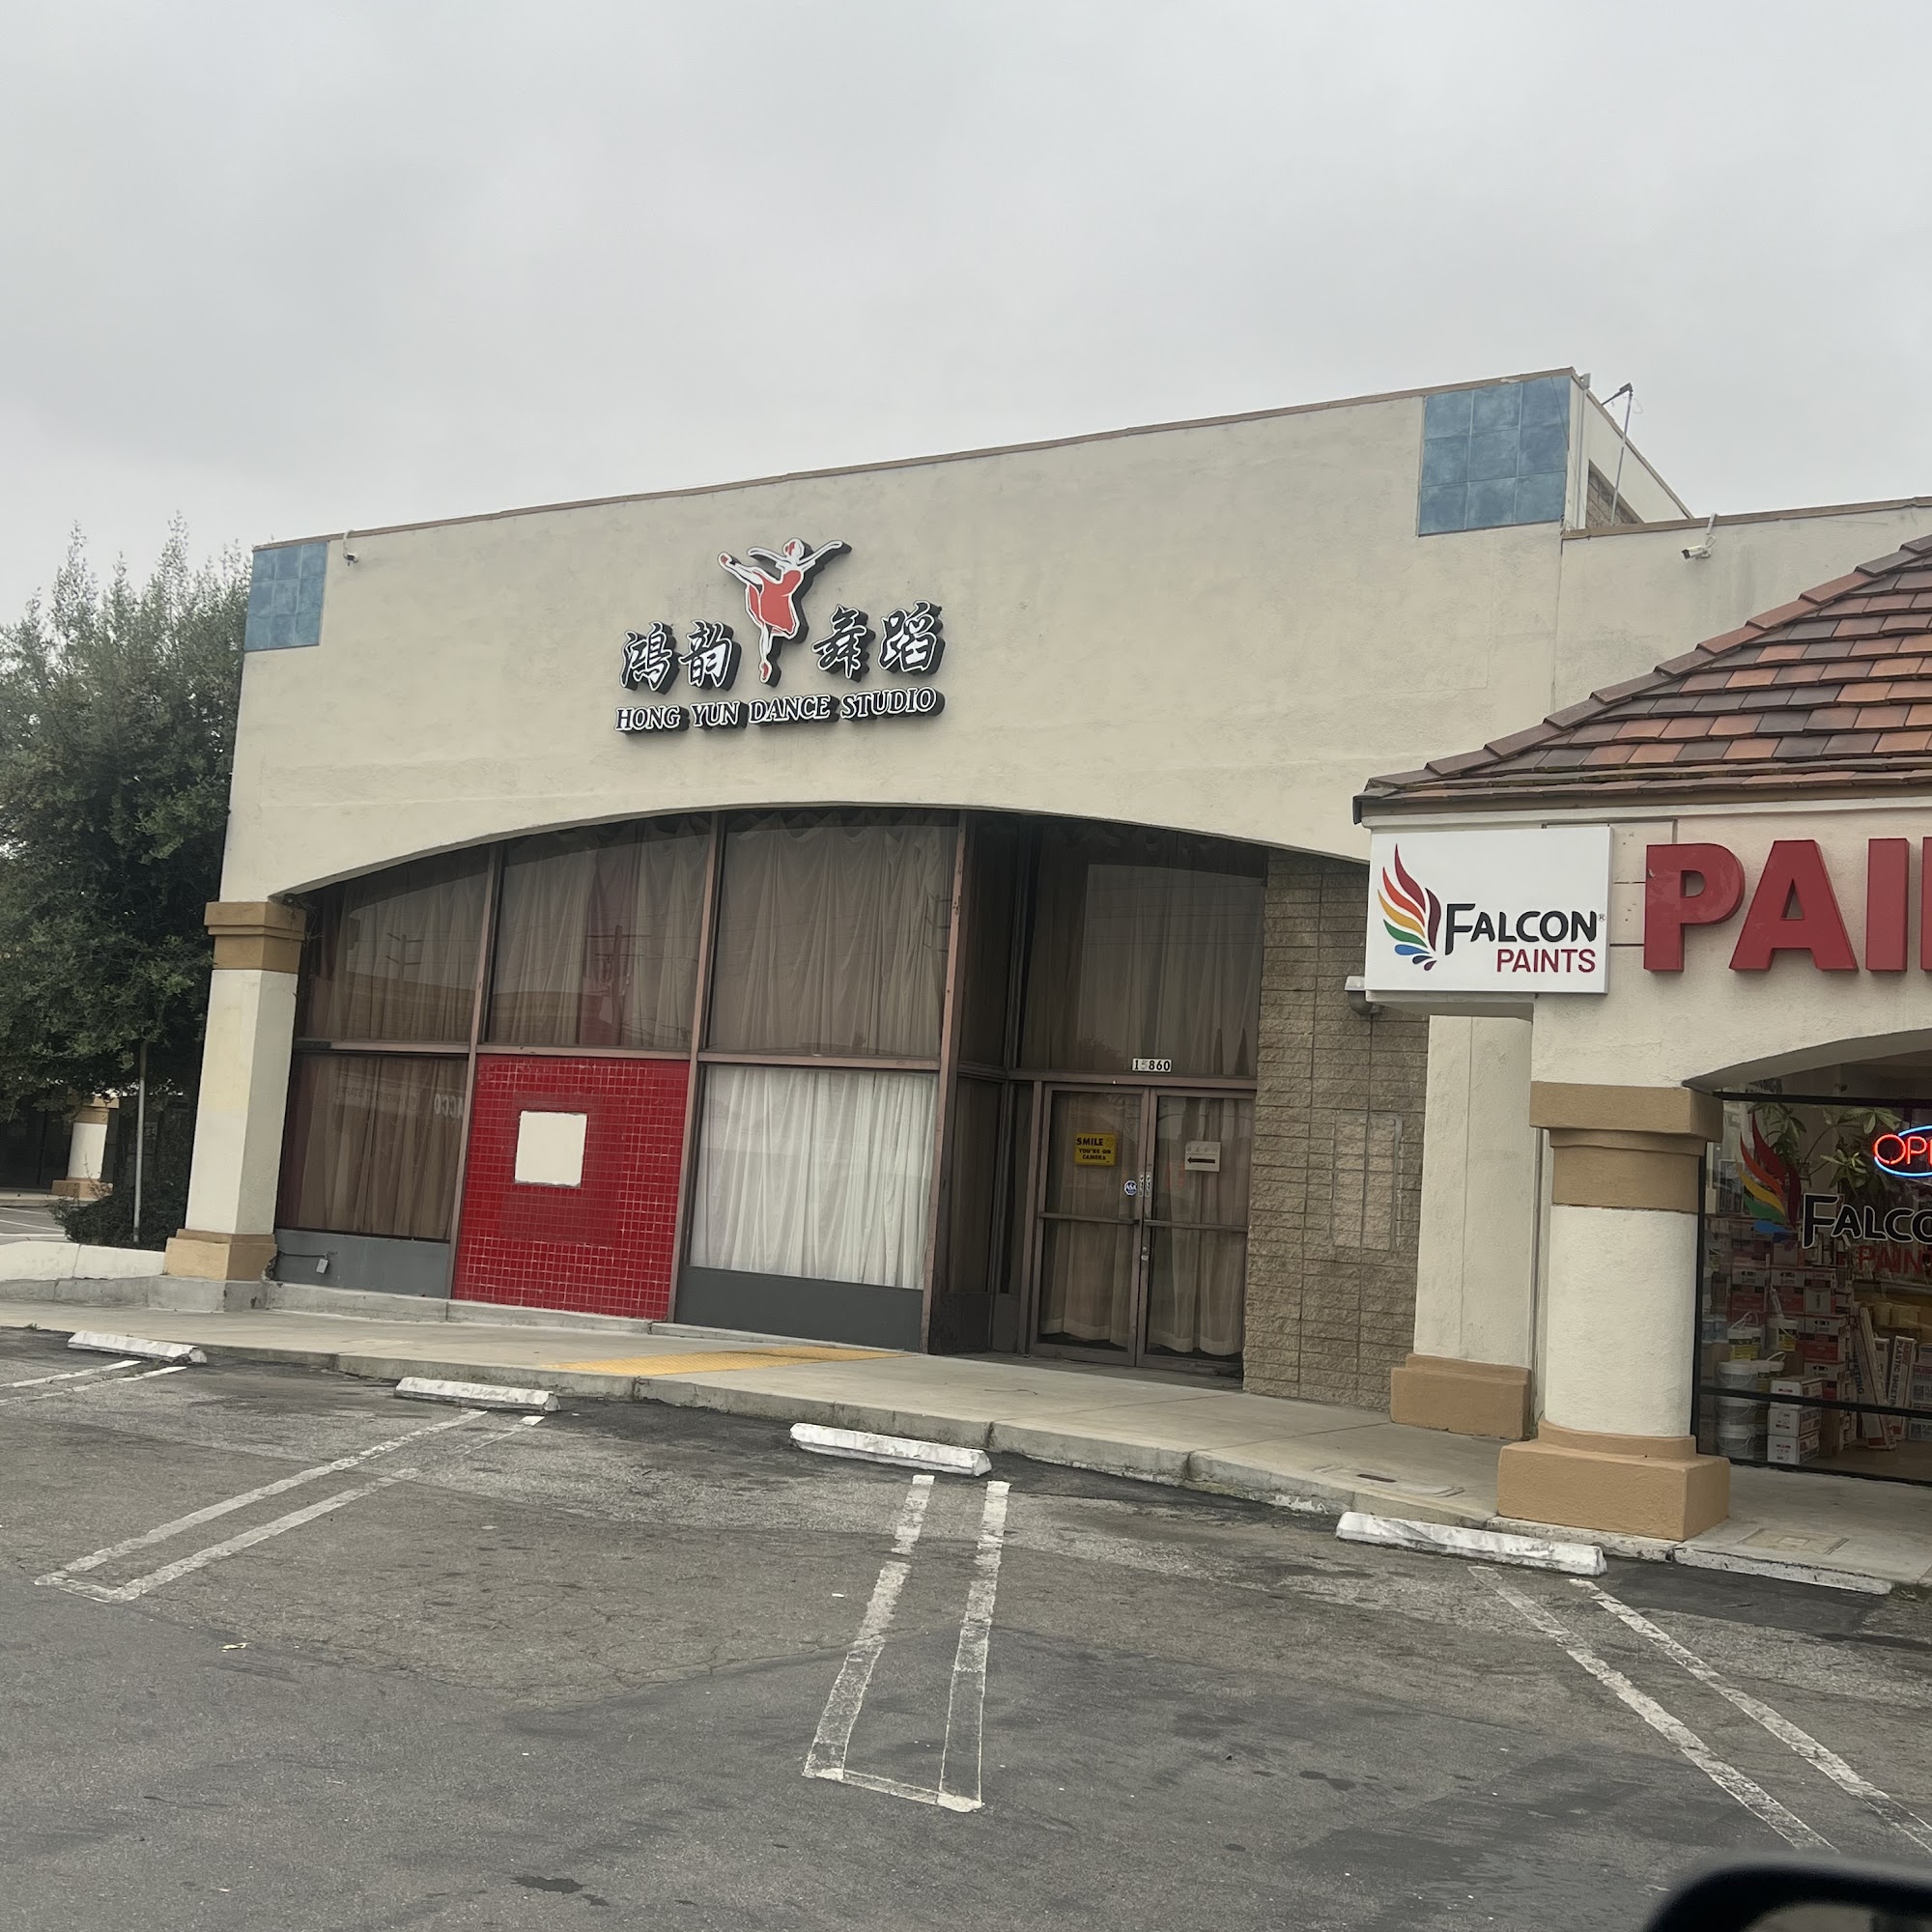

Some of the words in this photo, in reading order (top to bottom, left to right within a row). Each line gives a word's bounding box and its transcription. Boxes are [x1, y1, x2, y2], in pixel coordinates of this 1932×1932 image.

[811, 599, 943, 680] 舞蹈
[615, 704, 684, 733] HONG
[689, 700, 744, 729] YUN
[748, 694, 837, 724] DANCE
[839, 686, 941, 721] STUDIO
[1642, 836, 1932, 974] PAI
[1495, 947, 1597, 975] PAINTS
[1076, 1137, 1104, 1147] SMILE
[1873, 1133, 1932, 1167] OP
[1893, 1340, 1903, 1373] PLASTIC
[1889, 1374, 1900, 1406] SHEETIN
